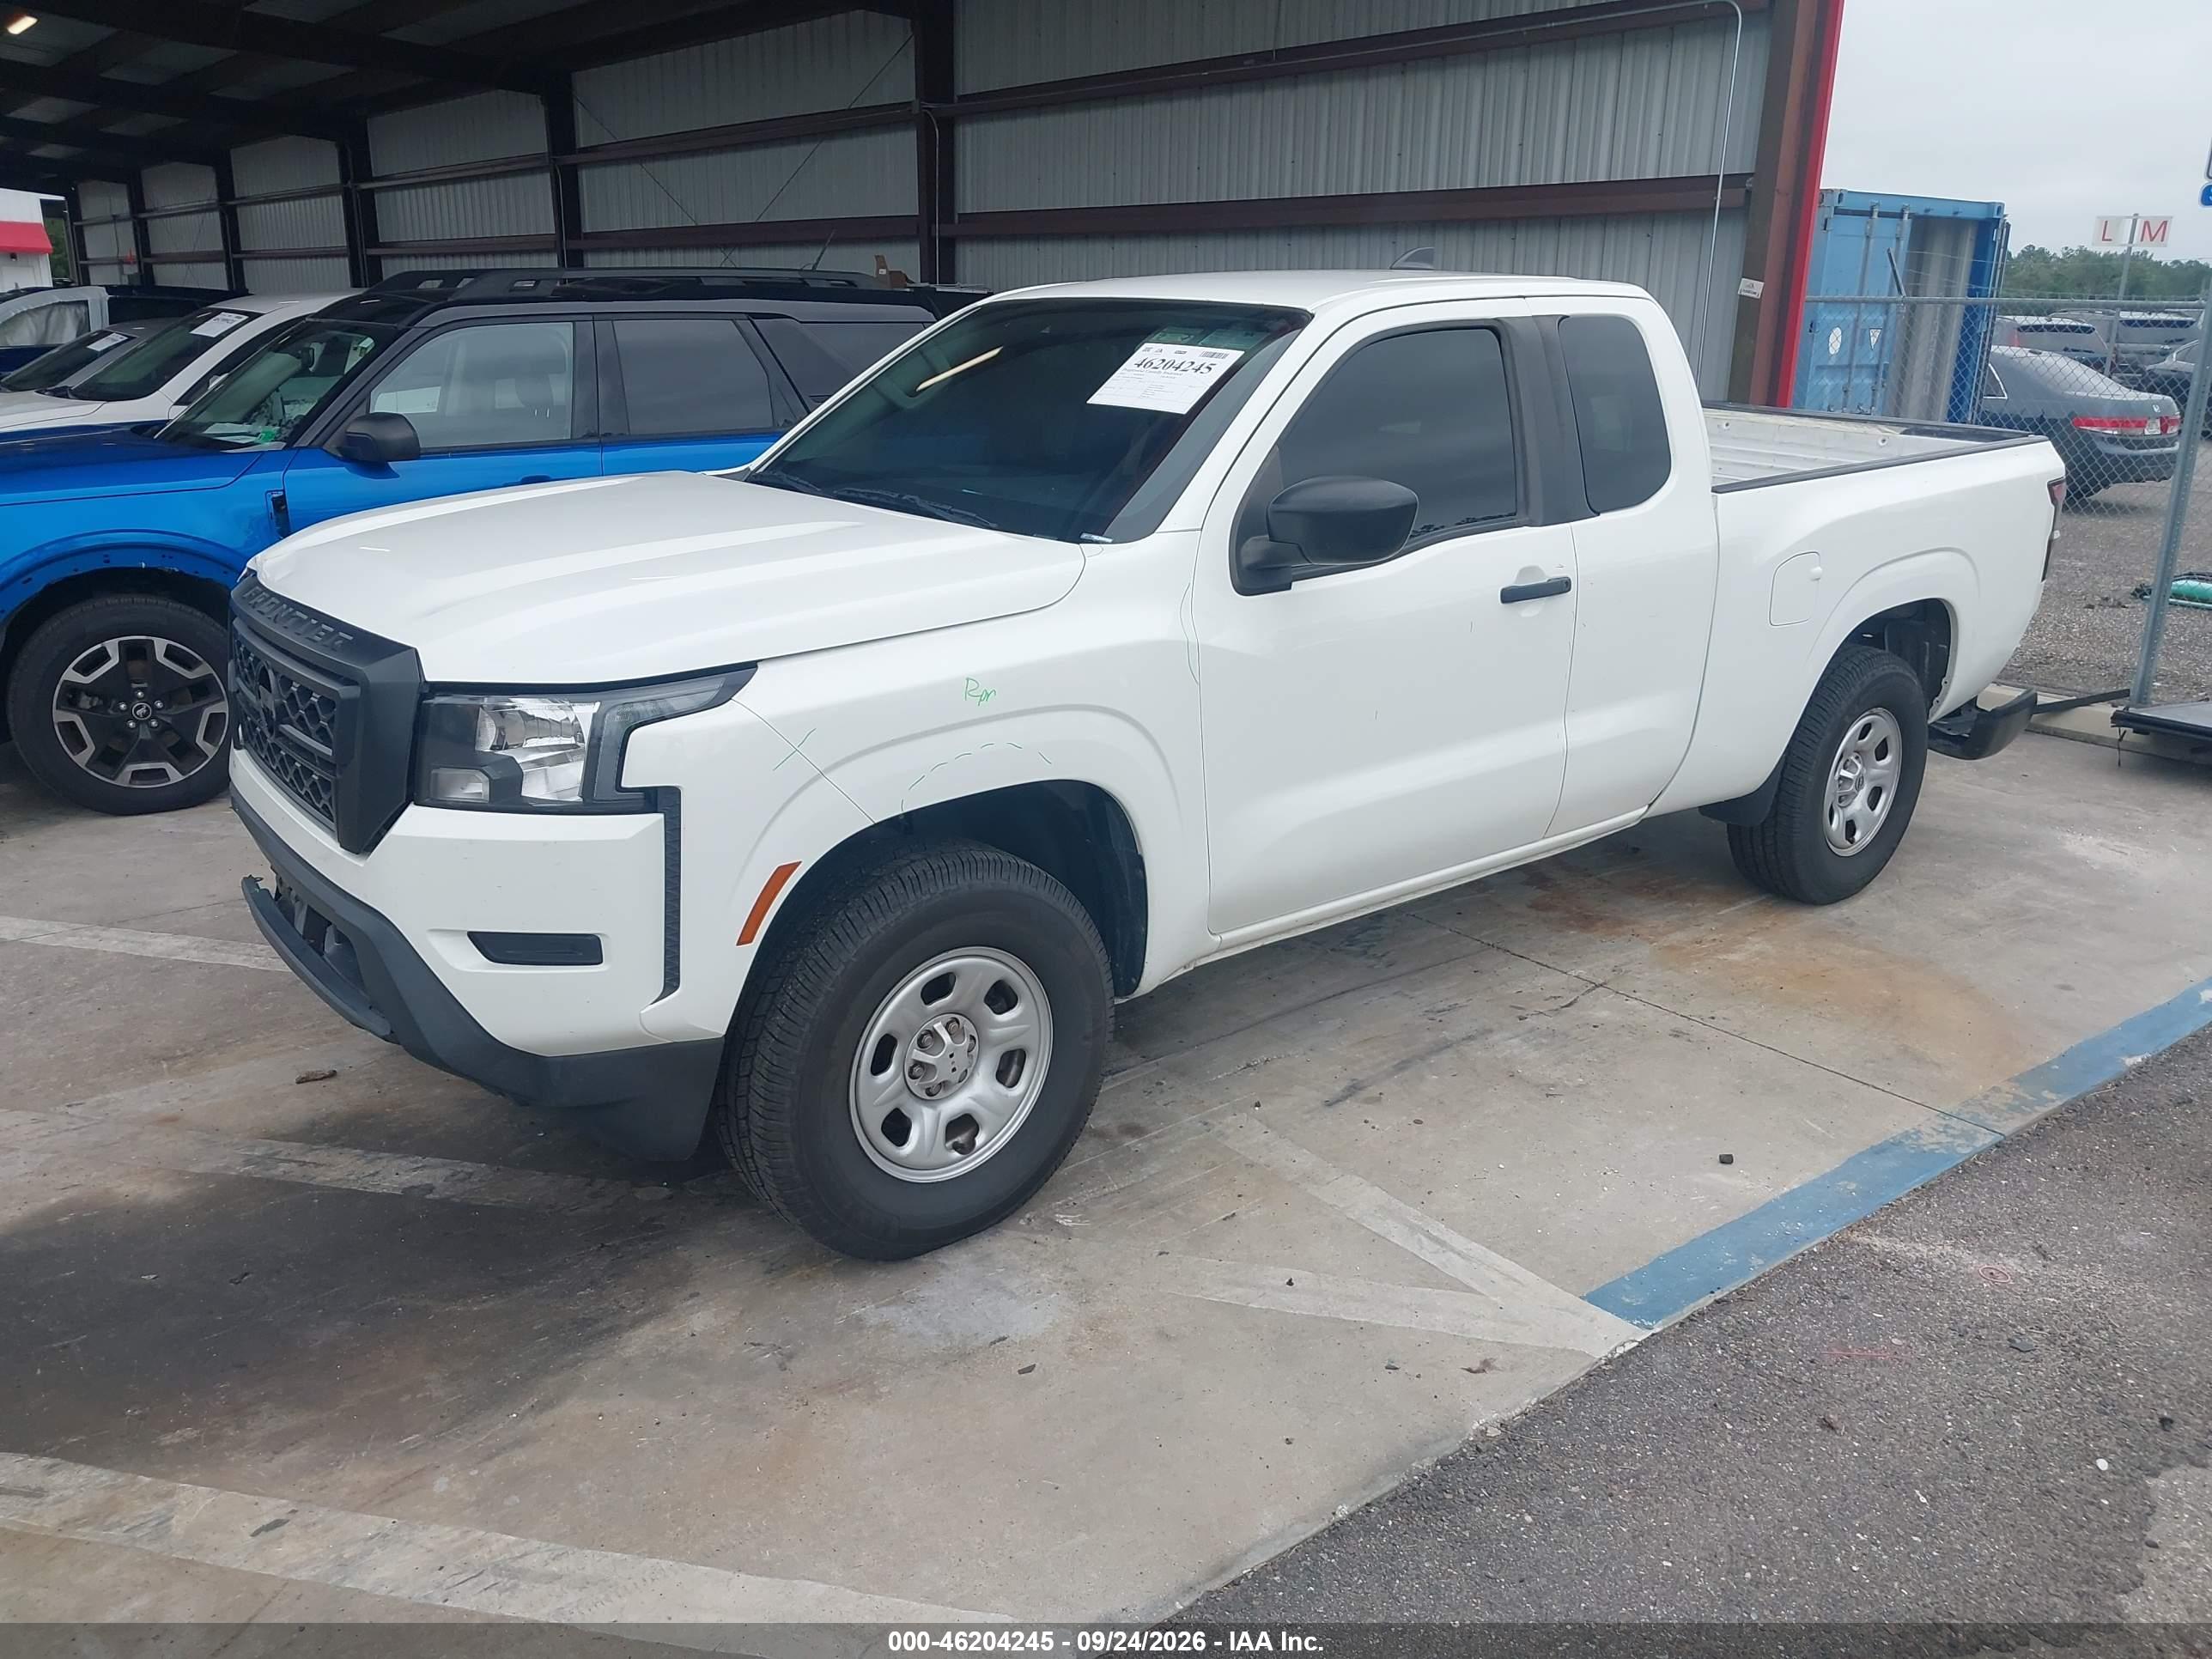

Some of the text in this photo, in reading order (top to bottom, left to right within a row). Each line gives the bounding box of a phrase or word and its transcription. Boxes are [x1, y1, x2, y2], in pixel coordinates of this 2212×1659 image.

[2101, 220, 2168, 242] L M
[1133, 356, 1218, 374] 46204245
[241, 585, 355, 653] FRONTIER
